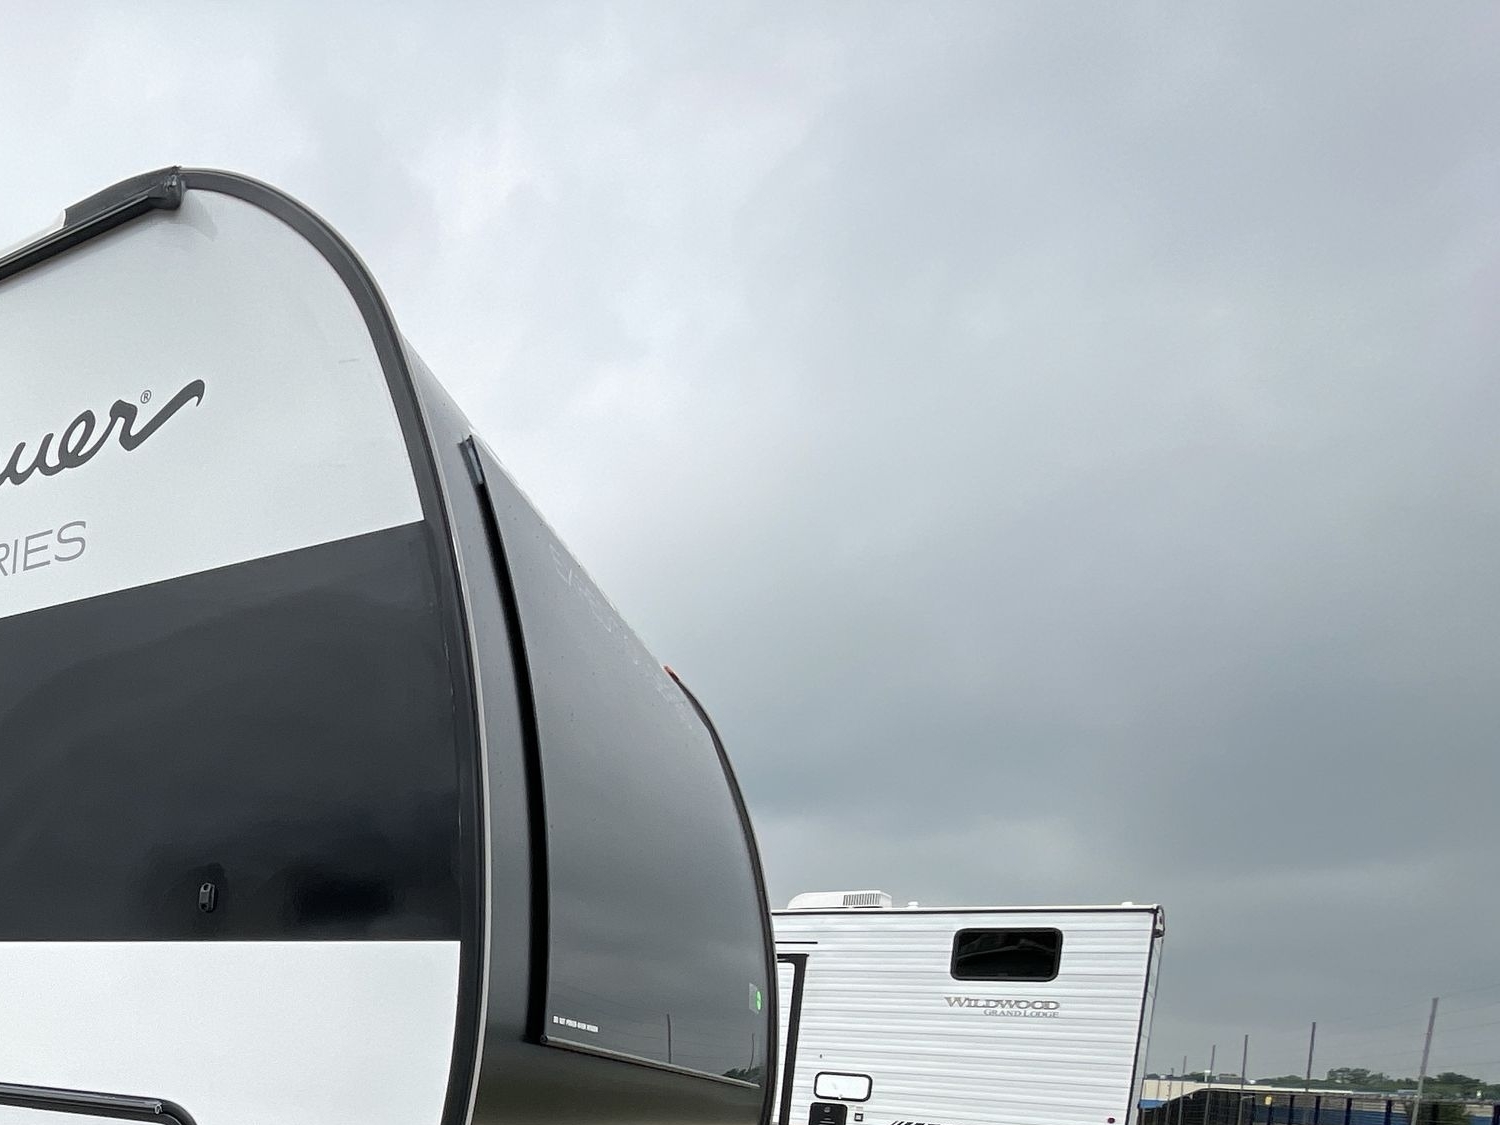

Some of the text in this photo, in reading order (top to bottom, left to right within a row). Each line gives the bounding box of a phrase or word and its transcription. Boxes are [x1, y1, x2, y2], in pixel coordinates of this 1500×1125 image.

[944, 997, 1060, 1010] WILDWOOD
[983, 1009, 1060, 1018] GRAND LODGE
